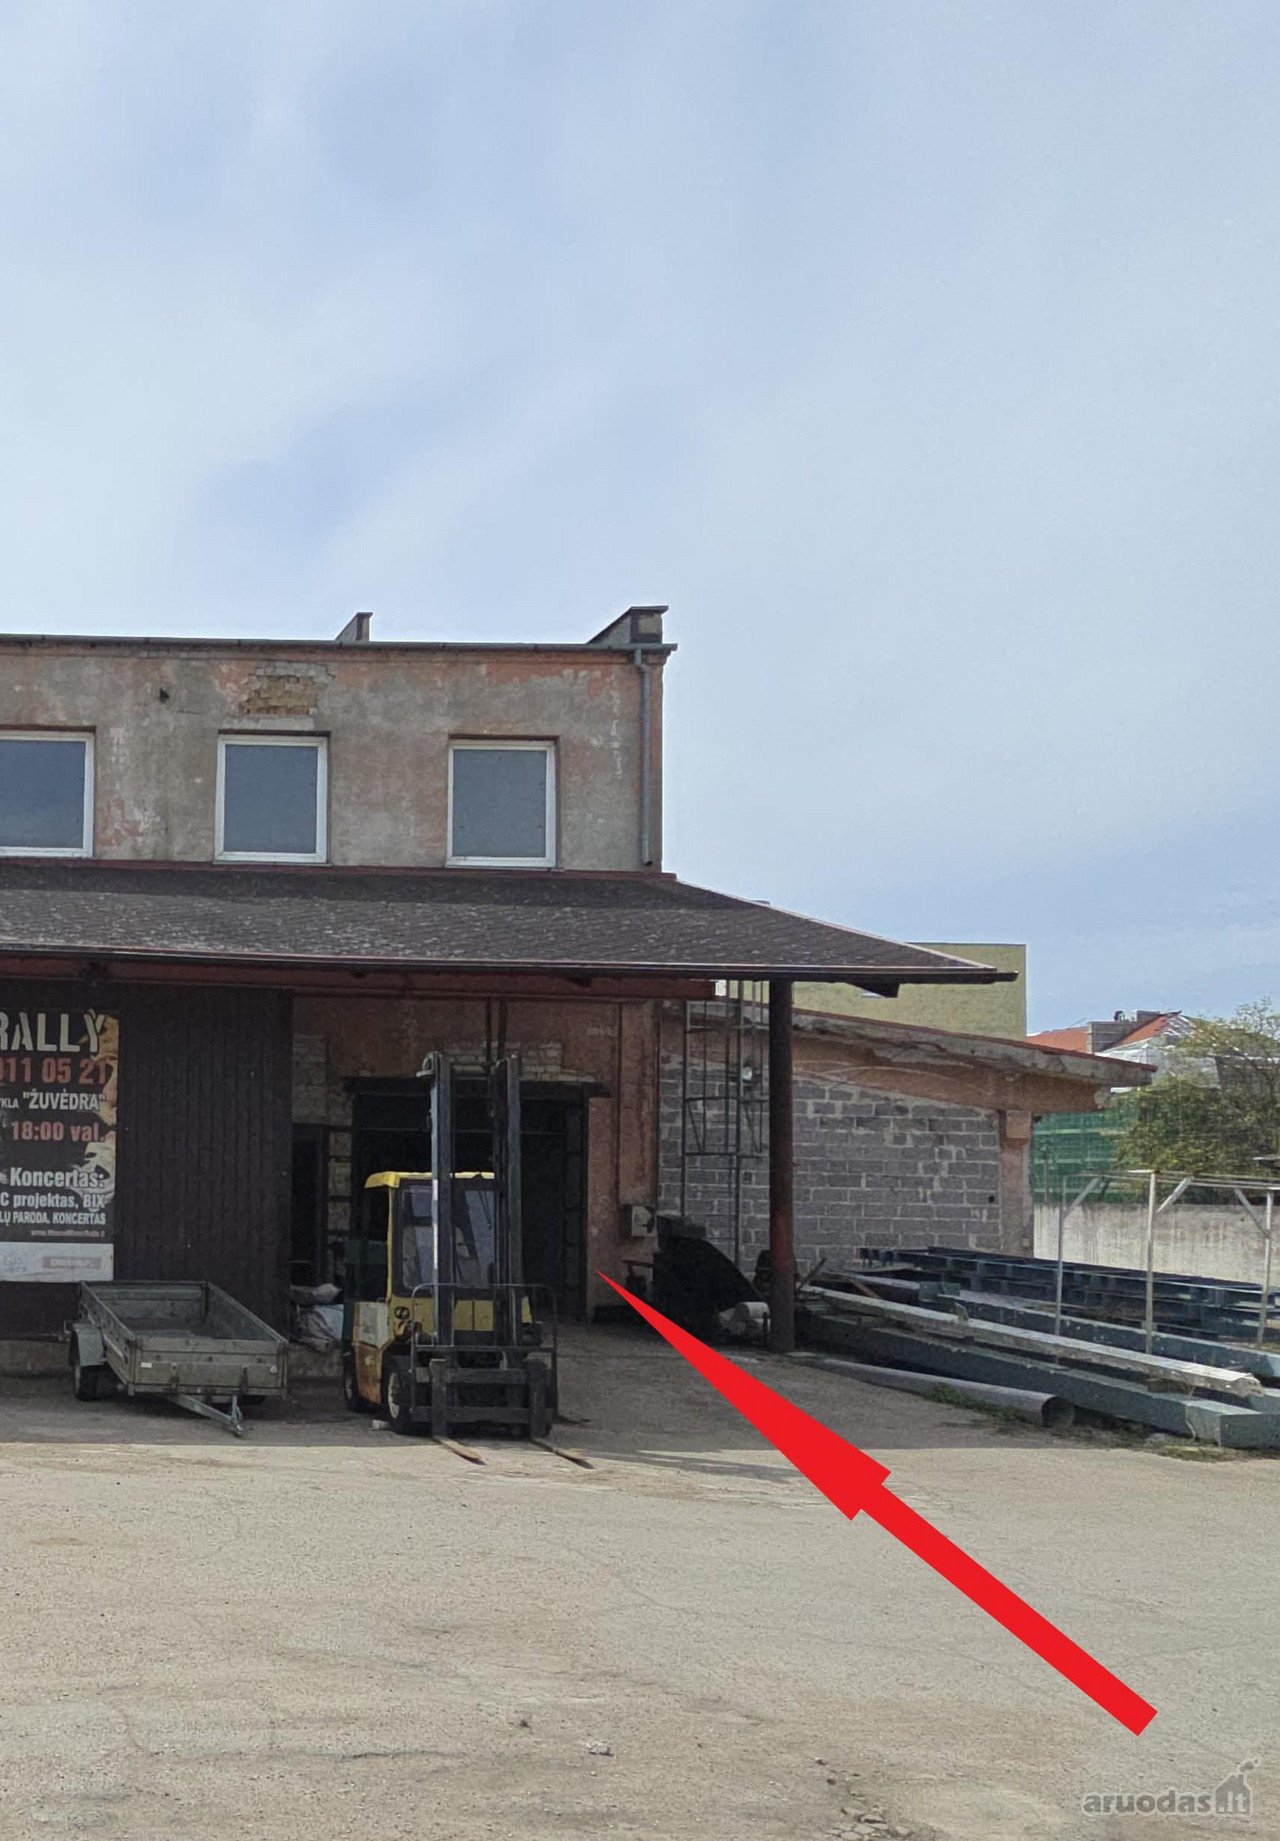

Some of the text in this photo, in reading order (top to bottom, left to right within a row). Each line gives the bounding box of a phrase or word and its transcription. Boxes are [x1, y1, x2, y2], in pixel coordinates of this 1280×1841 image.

[41, 1057, 72, 1084] 05
[78, 1059, 107, 1085] 21
[11, 1121, 106, 1142] 18:00 val.
[10, 1167, 106, 1188] Koncertas:
[82, 1194, 106, 1208] BIX
[52, 1212, 106, 1225] KONCERTAS
